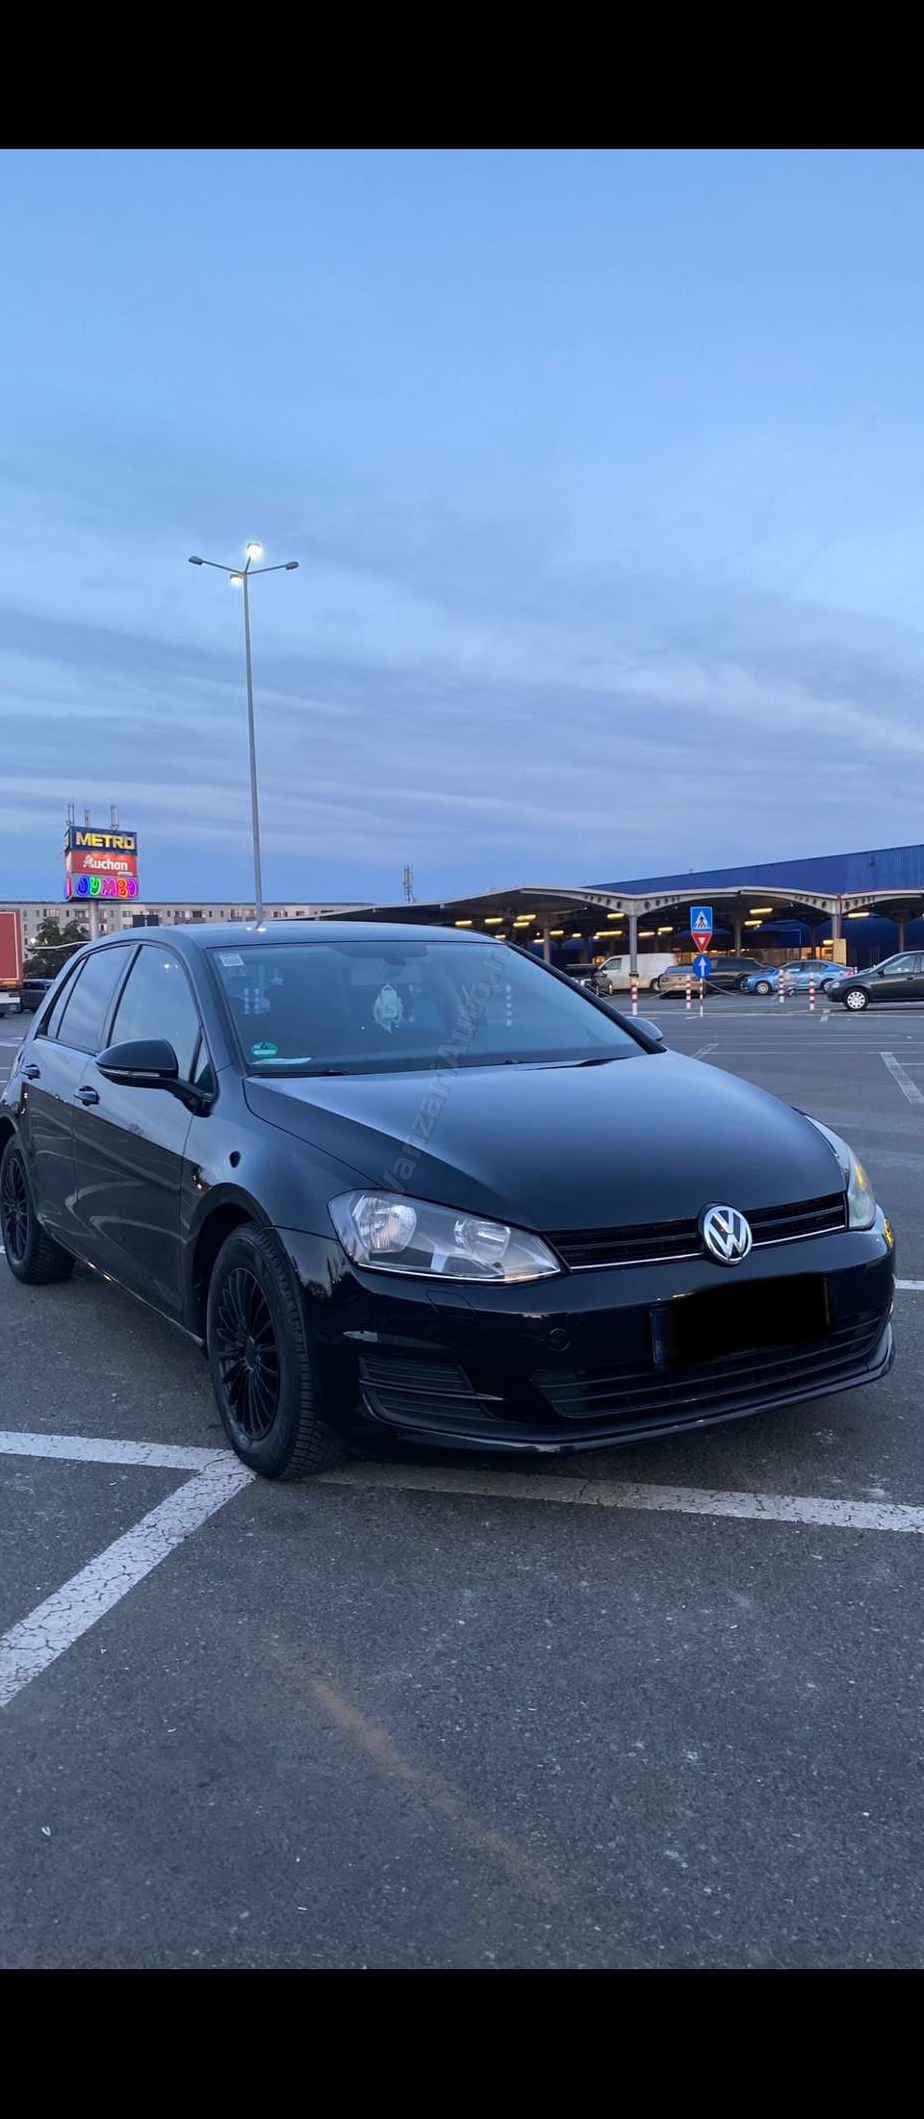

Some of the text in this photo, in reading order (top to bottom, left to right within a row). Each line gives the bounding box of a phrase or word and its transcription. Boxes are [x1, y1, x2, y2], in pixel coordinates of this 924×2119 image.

[76, 832, 134, 849] METRO
[83, 854, 128, 870] Auchan
[77, 875, 137, 896] JUMBO
[702, 1204, 753, 1264] VW
